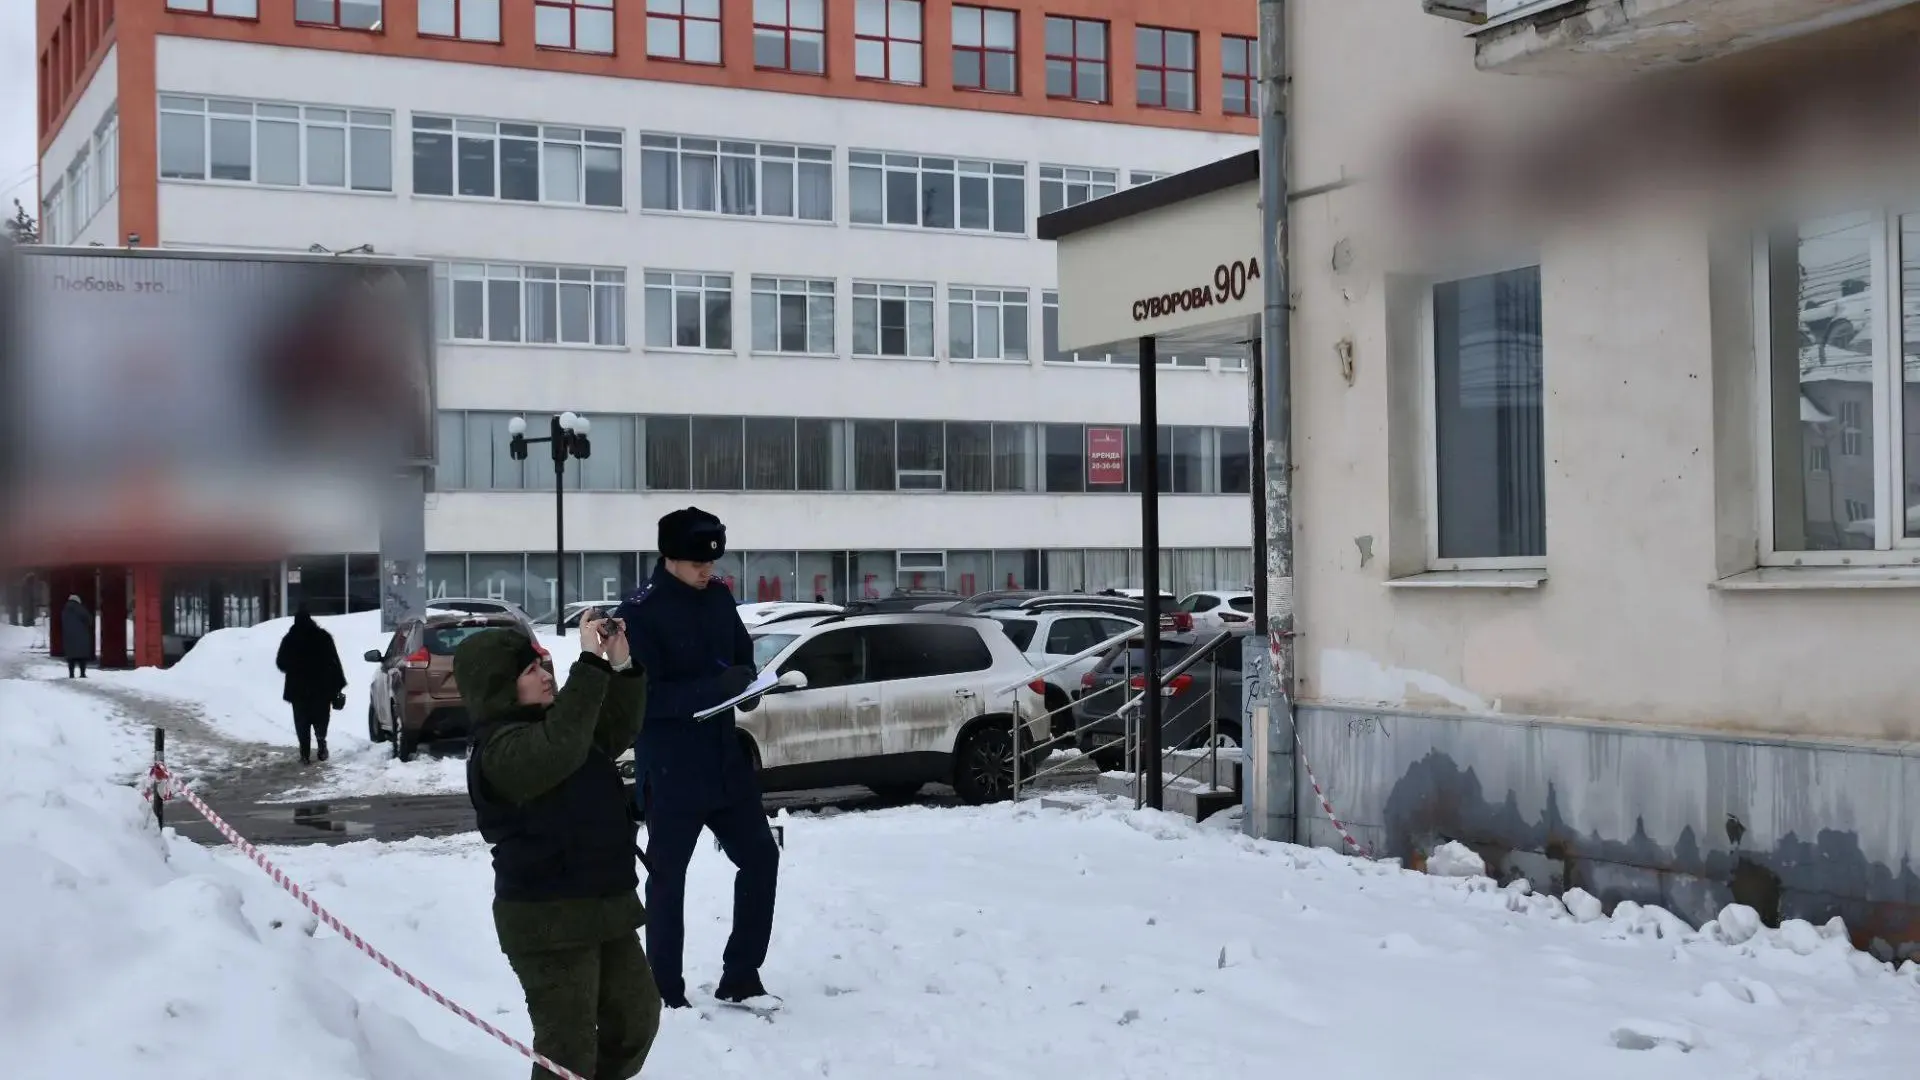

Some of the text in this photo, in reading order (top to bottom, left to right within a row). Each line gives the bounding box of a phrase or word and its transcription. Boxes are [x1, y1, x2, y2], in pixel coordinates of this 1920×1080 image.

[53, 275, 126, 293] Любовь
[1132, 285, 1213, 321] СУВОРОВА
[1091, 452, 1121, 460] АРЕНДА
